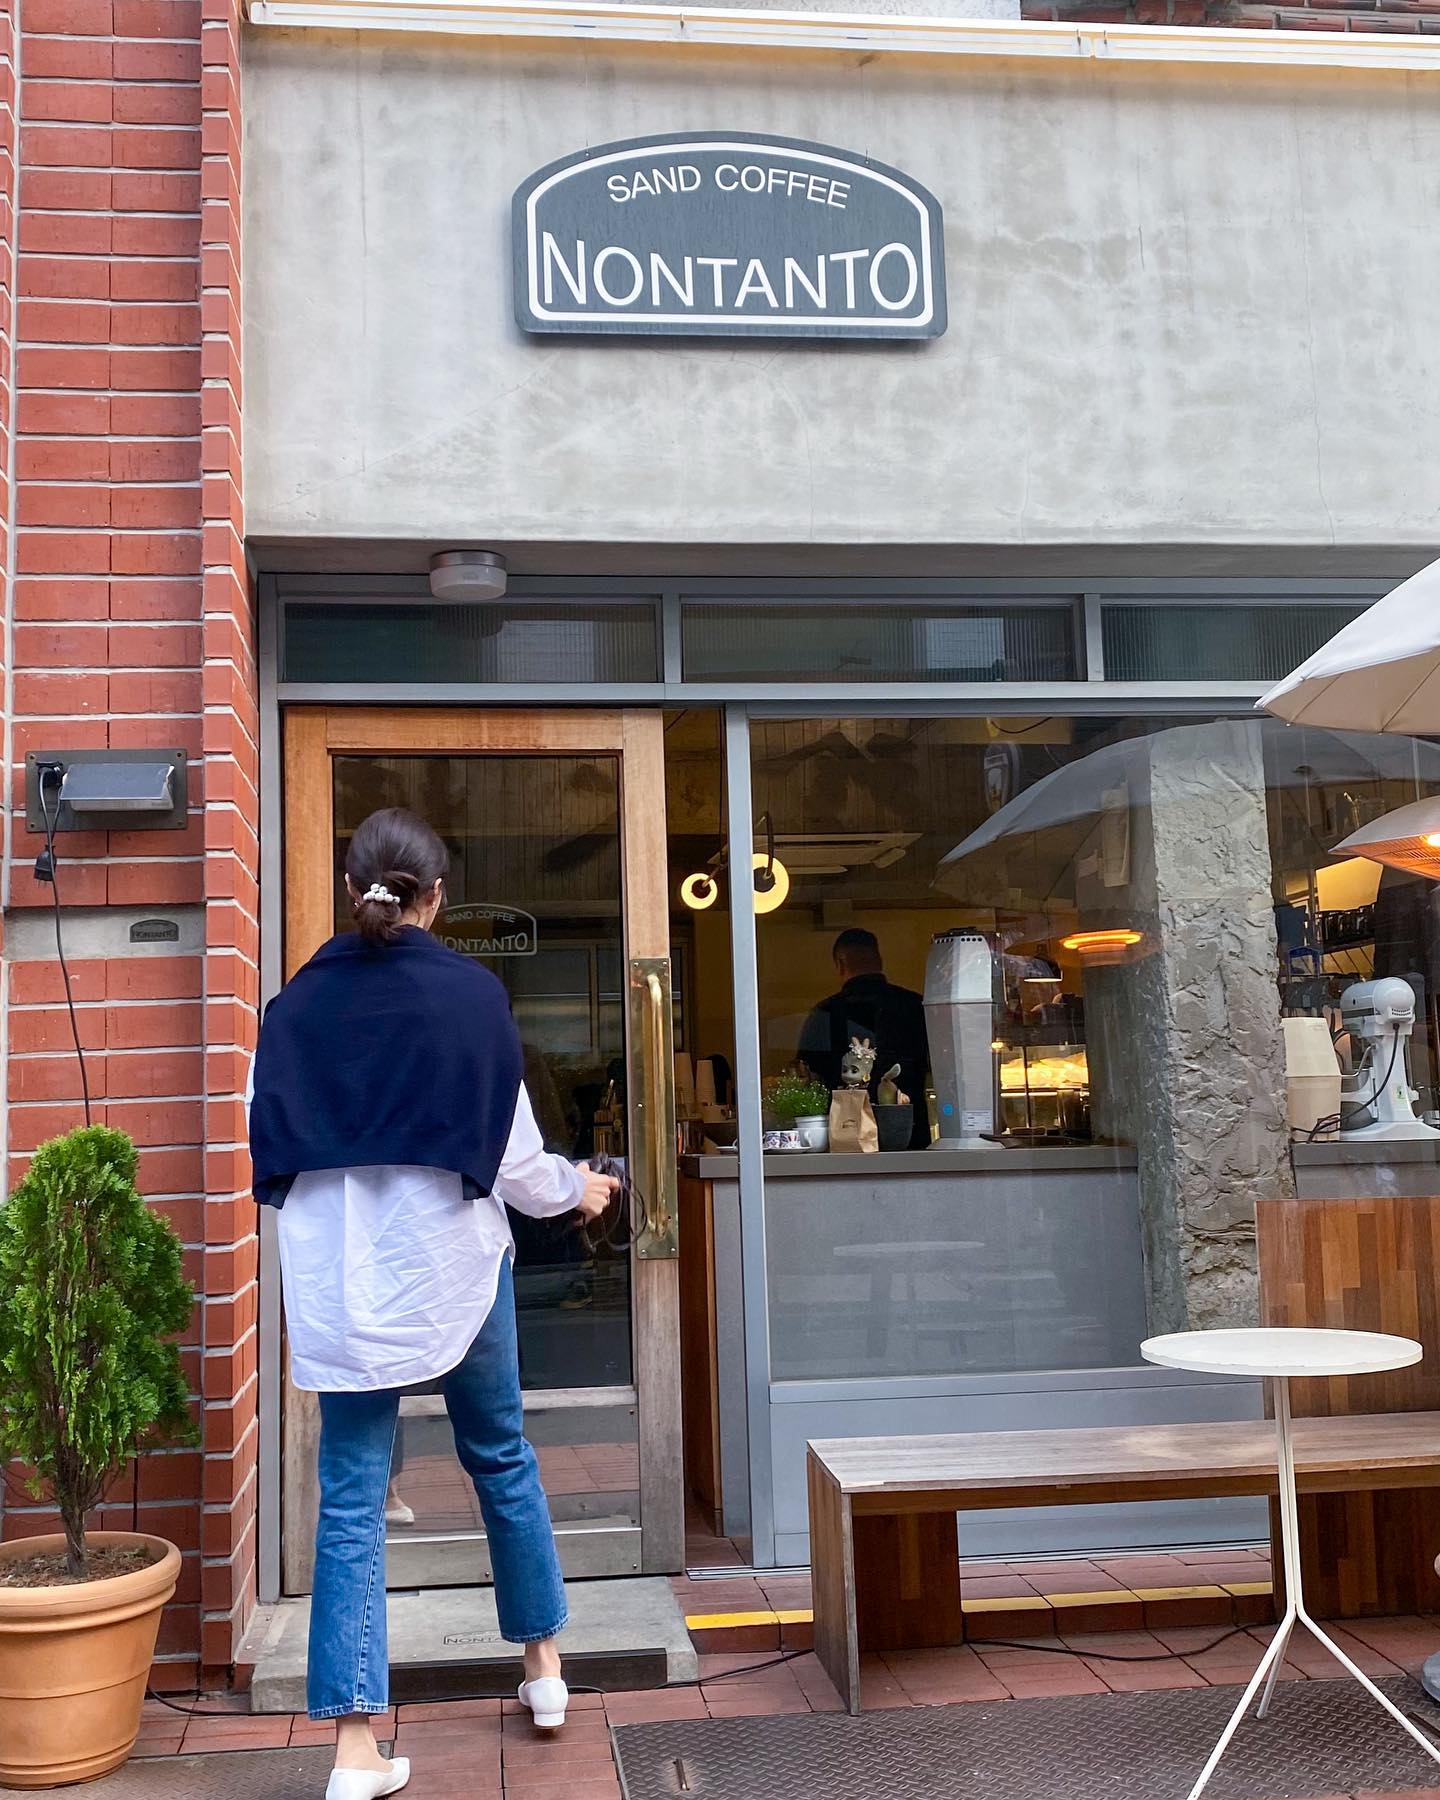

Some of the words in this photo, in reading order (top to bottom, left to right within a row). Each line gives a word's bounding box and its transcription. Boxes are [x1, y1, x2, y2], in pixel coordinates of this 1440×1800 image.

[607, 165, 701, 202] SAND
[715, 164, 851, 209] COFFEE
[543, 231, 918, 311] NONTANTO
[446, 910, 473, 923] SAND
[476, 910, 516, 923] COFFEE
